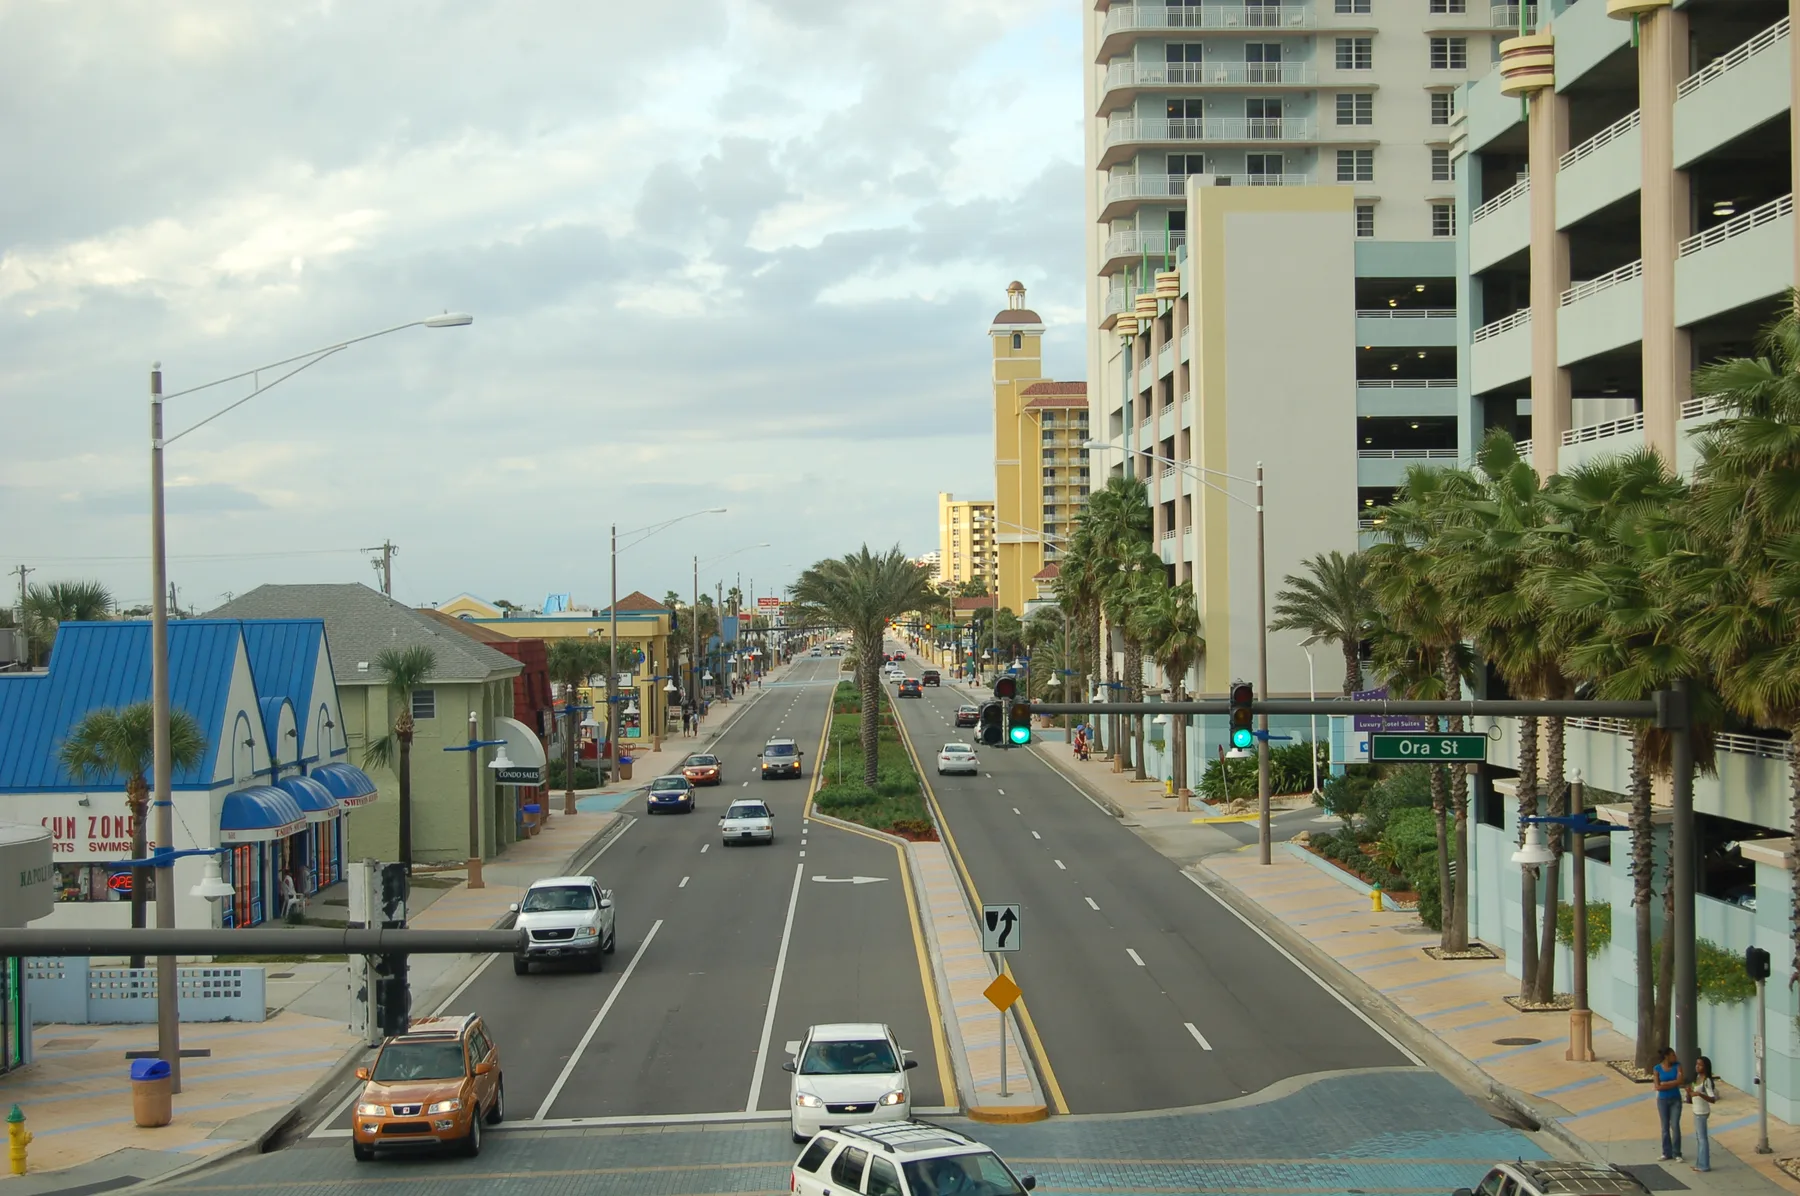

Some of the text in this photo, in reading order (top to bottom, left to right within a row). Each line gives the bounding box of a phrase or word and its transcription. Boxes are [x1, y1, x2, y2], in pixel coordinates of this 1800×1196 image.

[1399, 740, 1458, 755] Ora St
[89, 841, 156, 852] SWIMSS
[107, 875, 132, 888] OPE
